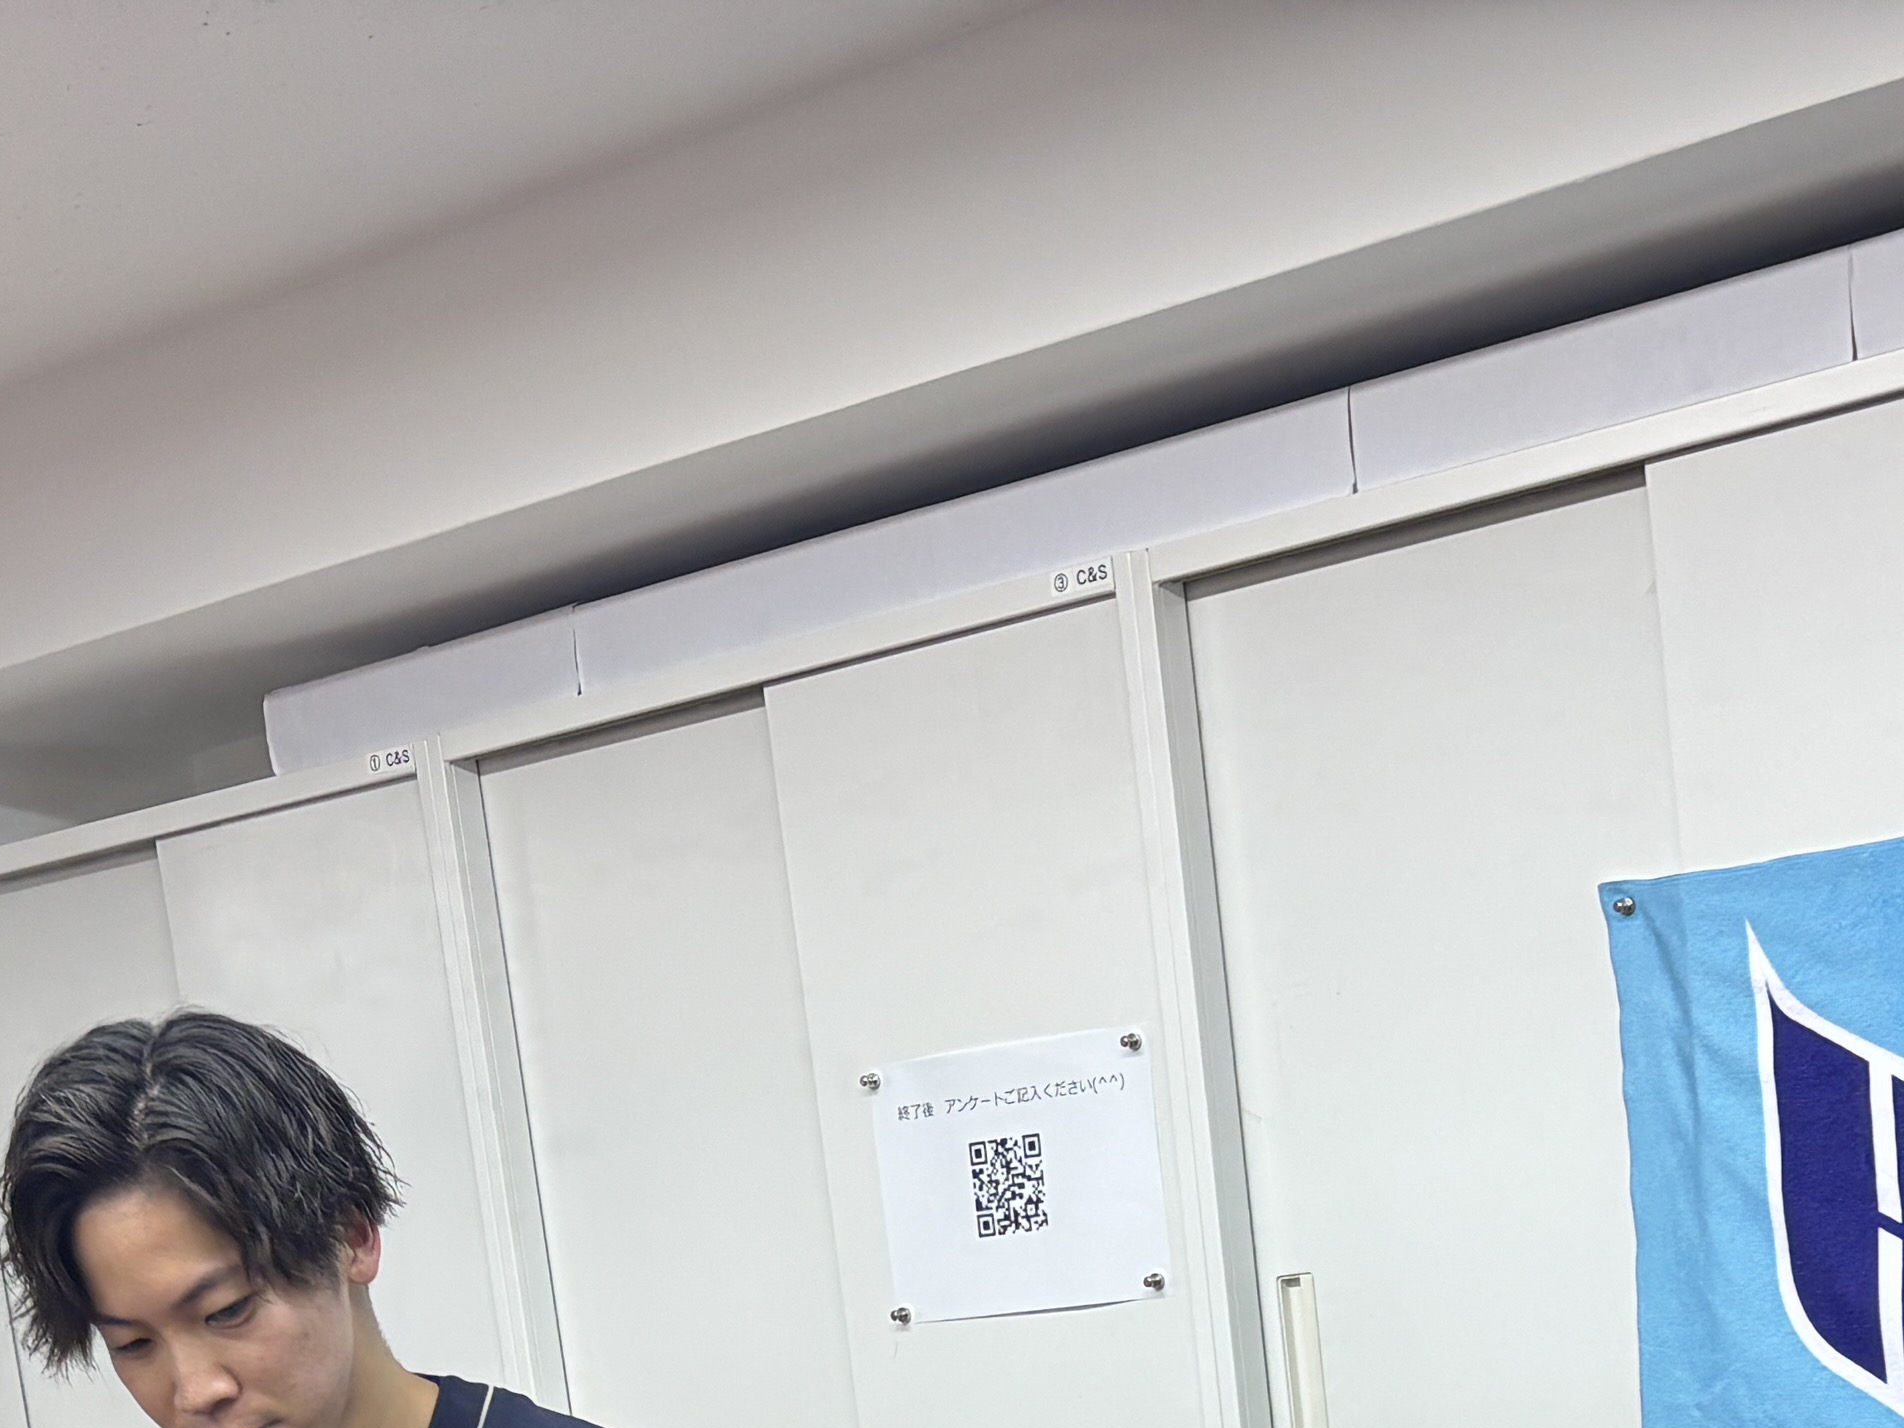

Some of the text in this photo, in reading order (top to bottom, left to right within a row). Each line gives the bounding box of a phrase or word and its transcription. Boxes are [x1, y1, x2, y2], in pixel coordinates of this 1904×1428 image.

[1077, 564, 1107, 585] C&S
[386, 749, 410, 766] C&S
[898, 1102, 934, 1121] 終了後
